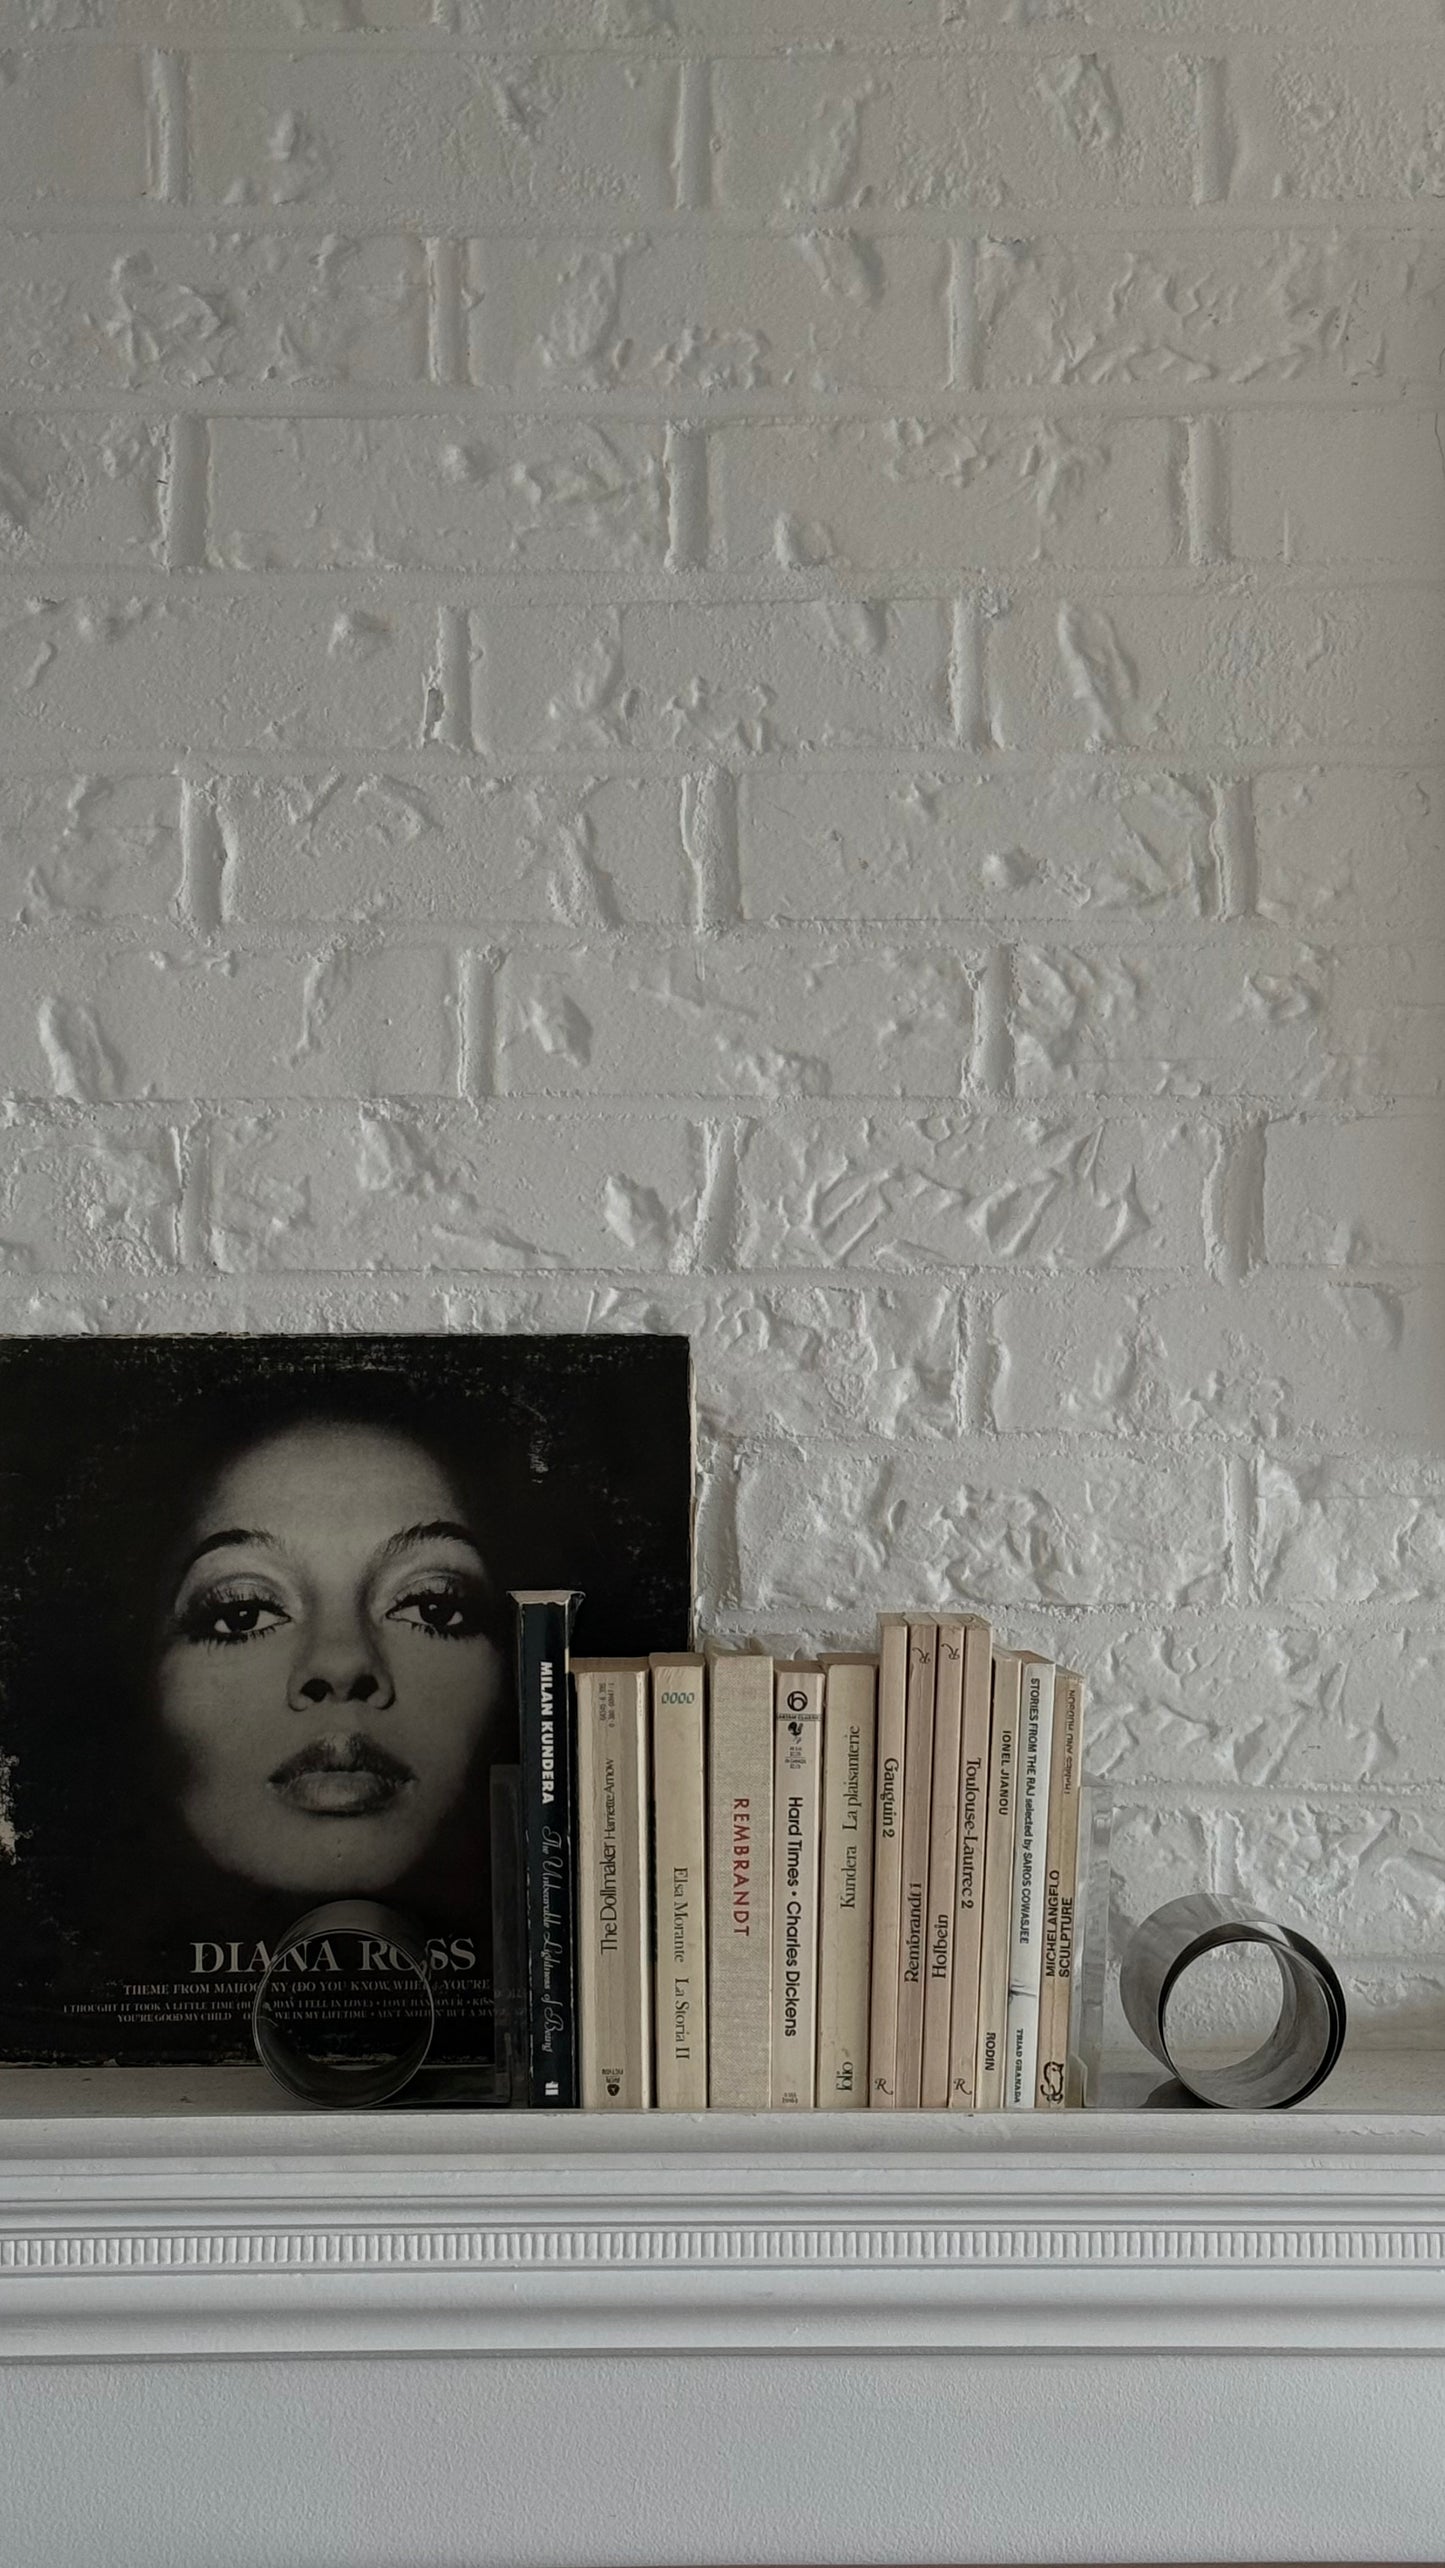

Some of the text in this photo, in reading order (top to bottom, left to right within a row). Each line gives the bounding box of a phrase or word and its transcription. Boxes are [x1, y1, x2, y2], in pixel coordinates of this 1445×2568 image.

[540, 1661, 554, 1804] MILAN KUNDERA
[999, 1730, 1012, 1815] IONEL JIANOU
[602, 1759, 616, 1794] Arnow
[880, 1757, 899, 1838] Gauguin 2
[1019, 1678, 1040, 1944] STORIES FROM THE RAJ selected by SAROS COWASJEE
[840, 1726, 862, 1909] Kundera La plaisanterie
[961, 1757, 982, 1909] Toulouse-Lautrec 2
[600, 1843, 618, 1922] Dollmaker
[733, 1797, 750, 1937] REMBRANDT
[539, 1825, 564, 2052] The Unbearable Lightness of Being
[600, 1923, 618, 1955] The
[674, 1867, 688, 1963] Elsa Morante
[785, 1796, 803, 2037] Hard Times Charles Dickens
[904, 1891, 921, 1983] Rembrandt
[932, 1914, 948, 1979] Holbein
[1045, 1870, 1060, 1977] MICHELANGELO
[1059, 1897, 1072, 1978] SCULPTURE
[123, 1984, 169, 1995] THEME
[173, 1984, 210, 1995] FROM
[320, 1981, 343, 1992] YOU
[443, 1979, 490, 1991] YOU'RE
[189, 1940, 343, 1974] DIANA
[70, 2003, 118, 2013] THOUGHT
[121, 2003, 131, 2012] IT
[134, 2002, 161, 2012] TOOK
[172, 2001, 209, 2011] LITTLE
[211, 2001, 233, 2010] TIME
[154, 2013, 183, 2022] GOOD
[184, 2012, 199, 2021] MY
[200, 2012, 232, 2021] CHILD
[675, 1978, 690, 2060] La Storia II
[1015, 2028, 1024, 2057] TRIAD
[836, 2061, 853, 2091] folio
[985, 2032, 997, 2070] RODIN
